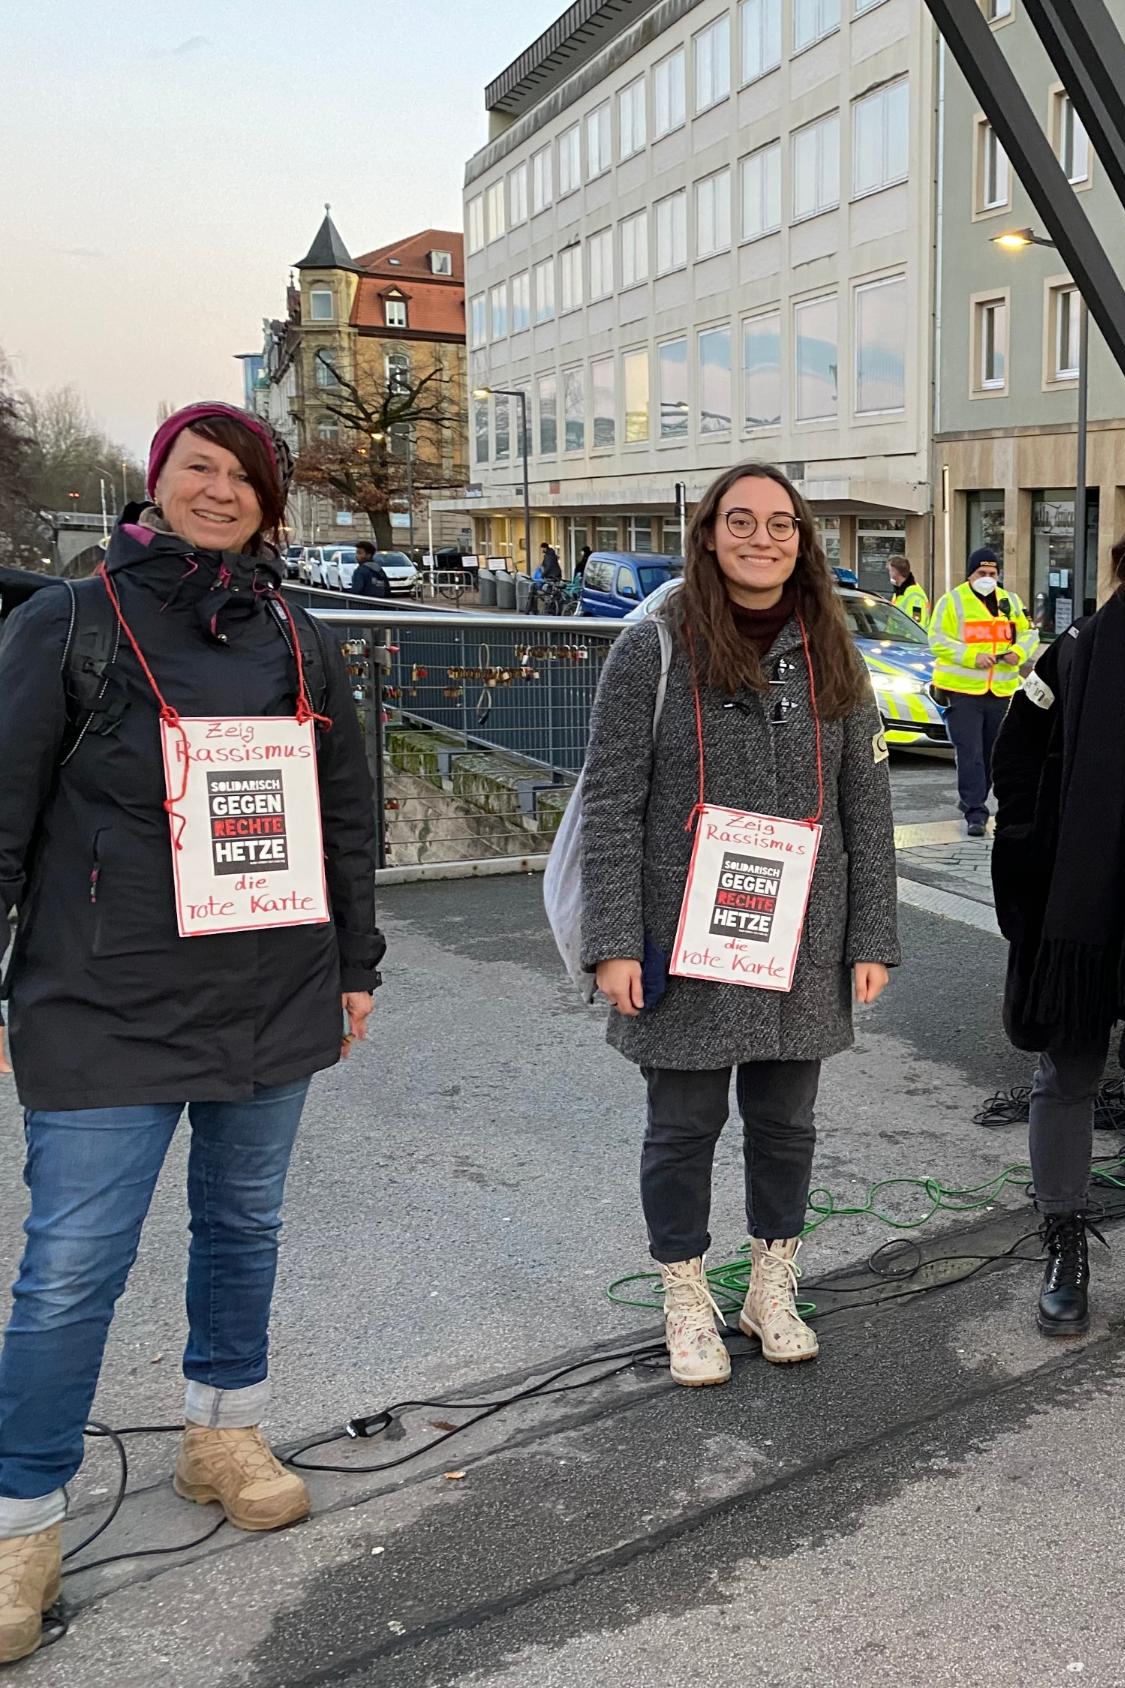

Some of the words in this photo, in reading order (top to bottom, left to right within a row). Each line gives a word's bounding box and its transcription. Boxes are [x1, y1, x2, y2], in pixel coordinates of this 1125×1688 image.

[205, 722, 255, 743] Zeig
[175, 740, 312, 762] Rassismus
[210, 778, 281, 793] SOLIDARISCH
[212, 794, 282, 816] GEGEN
[213, 816, 284, 838] RECHTE
[725, 814, 775, 835] Zeig
[706, 823, 806, 855] Rassismus
[215, 838, 286, 863] HETZE
[724, 860, 780, 878] SOLIDARISCH
[234, 874, 269, 891] die
[721, 872, 779, 896] GEGEN
[186, 895, 237, 919] rote
[250, 891, 317, 914] Karte
[717, 889, 775, 912] RECHTE
[713, 908, 772, 933] HETZE
[724, 936, 748, 952] die
[682, 948, 724, 968] rote
[731, 954, 786, 979] Karte
